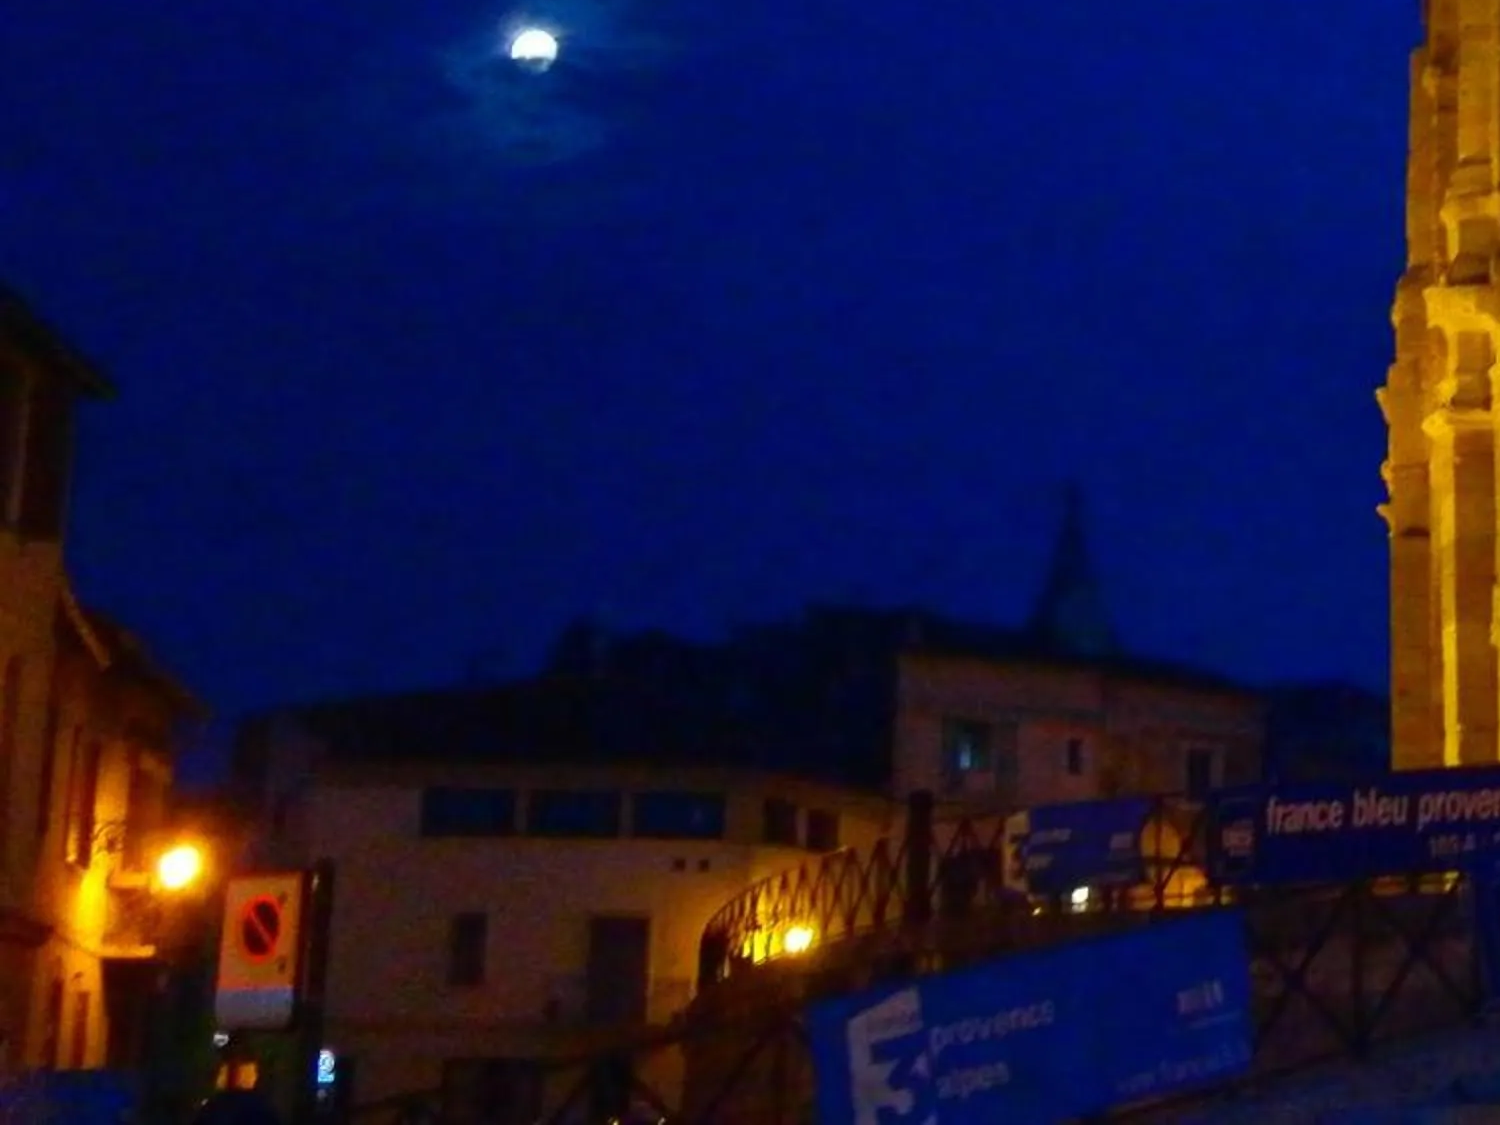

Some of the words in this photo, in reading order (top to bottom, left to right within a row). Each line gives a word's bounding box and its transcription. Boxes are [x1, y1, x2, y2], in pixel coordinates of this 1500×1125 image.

[1266, 794, 1345, 836] france
[1352, 786, 1409, 828] bleu
[928, 998, 1055, 1058] provence
